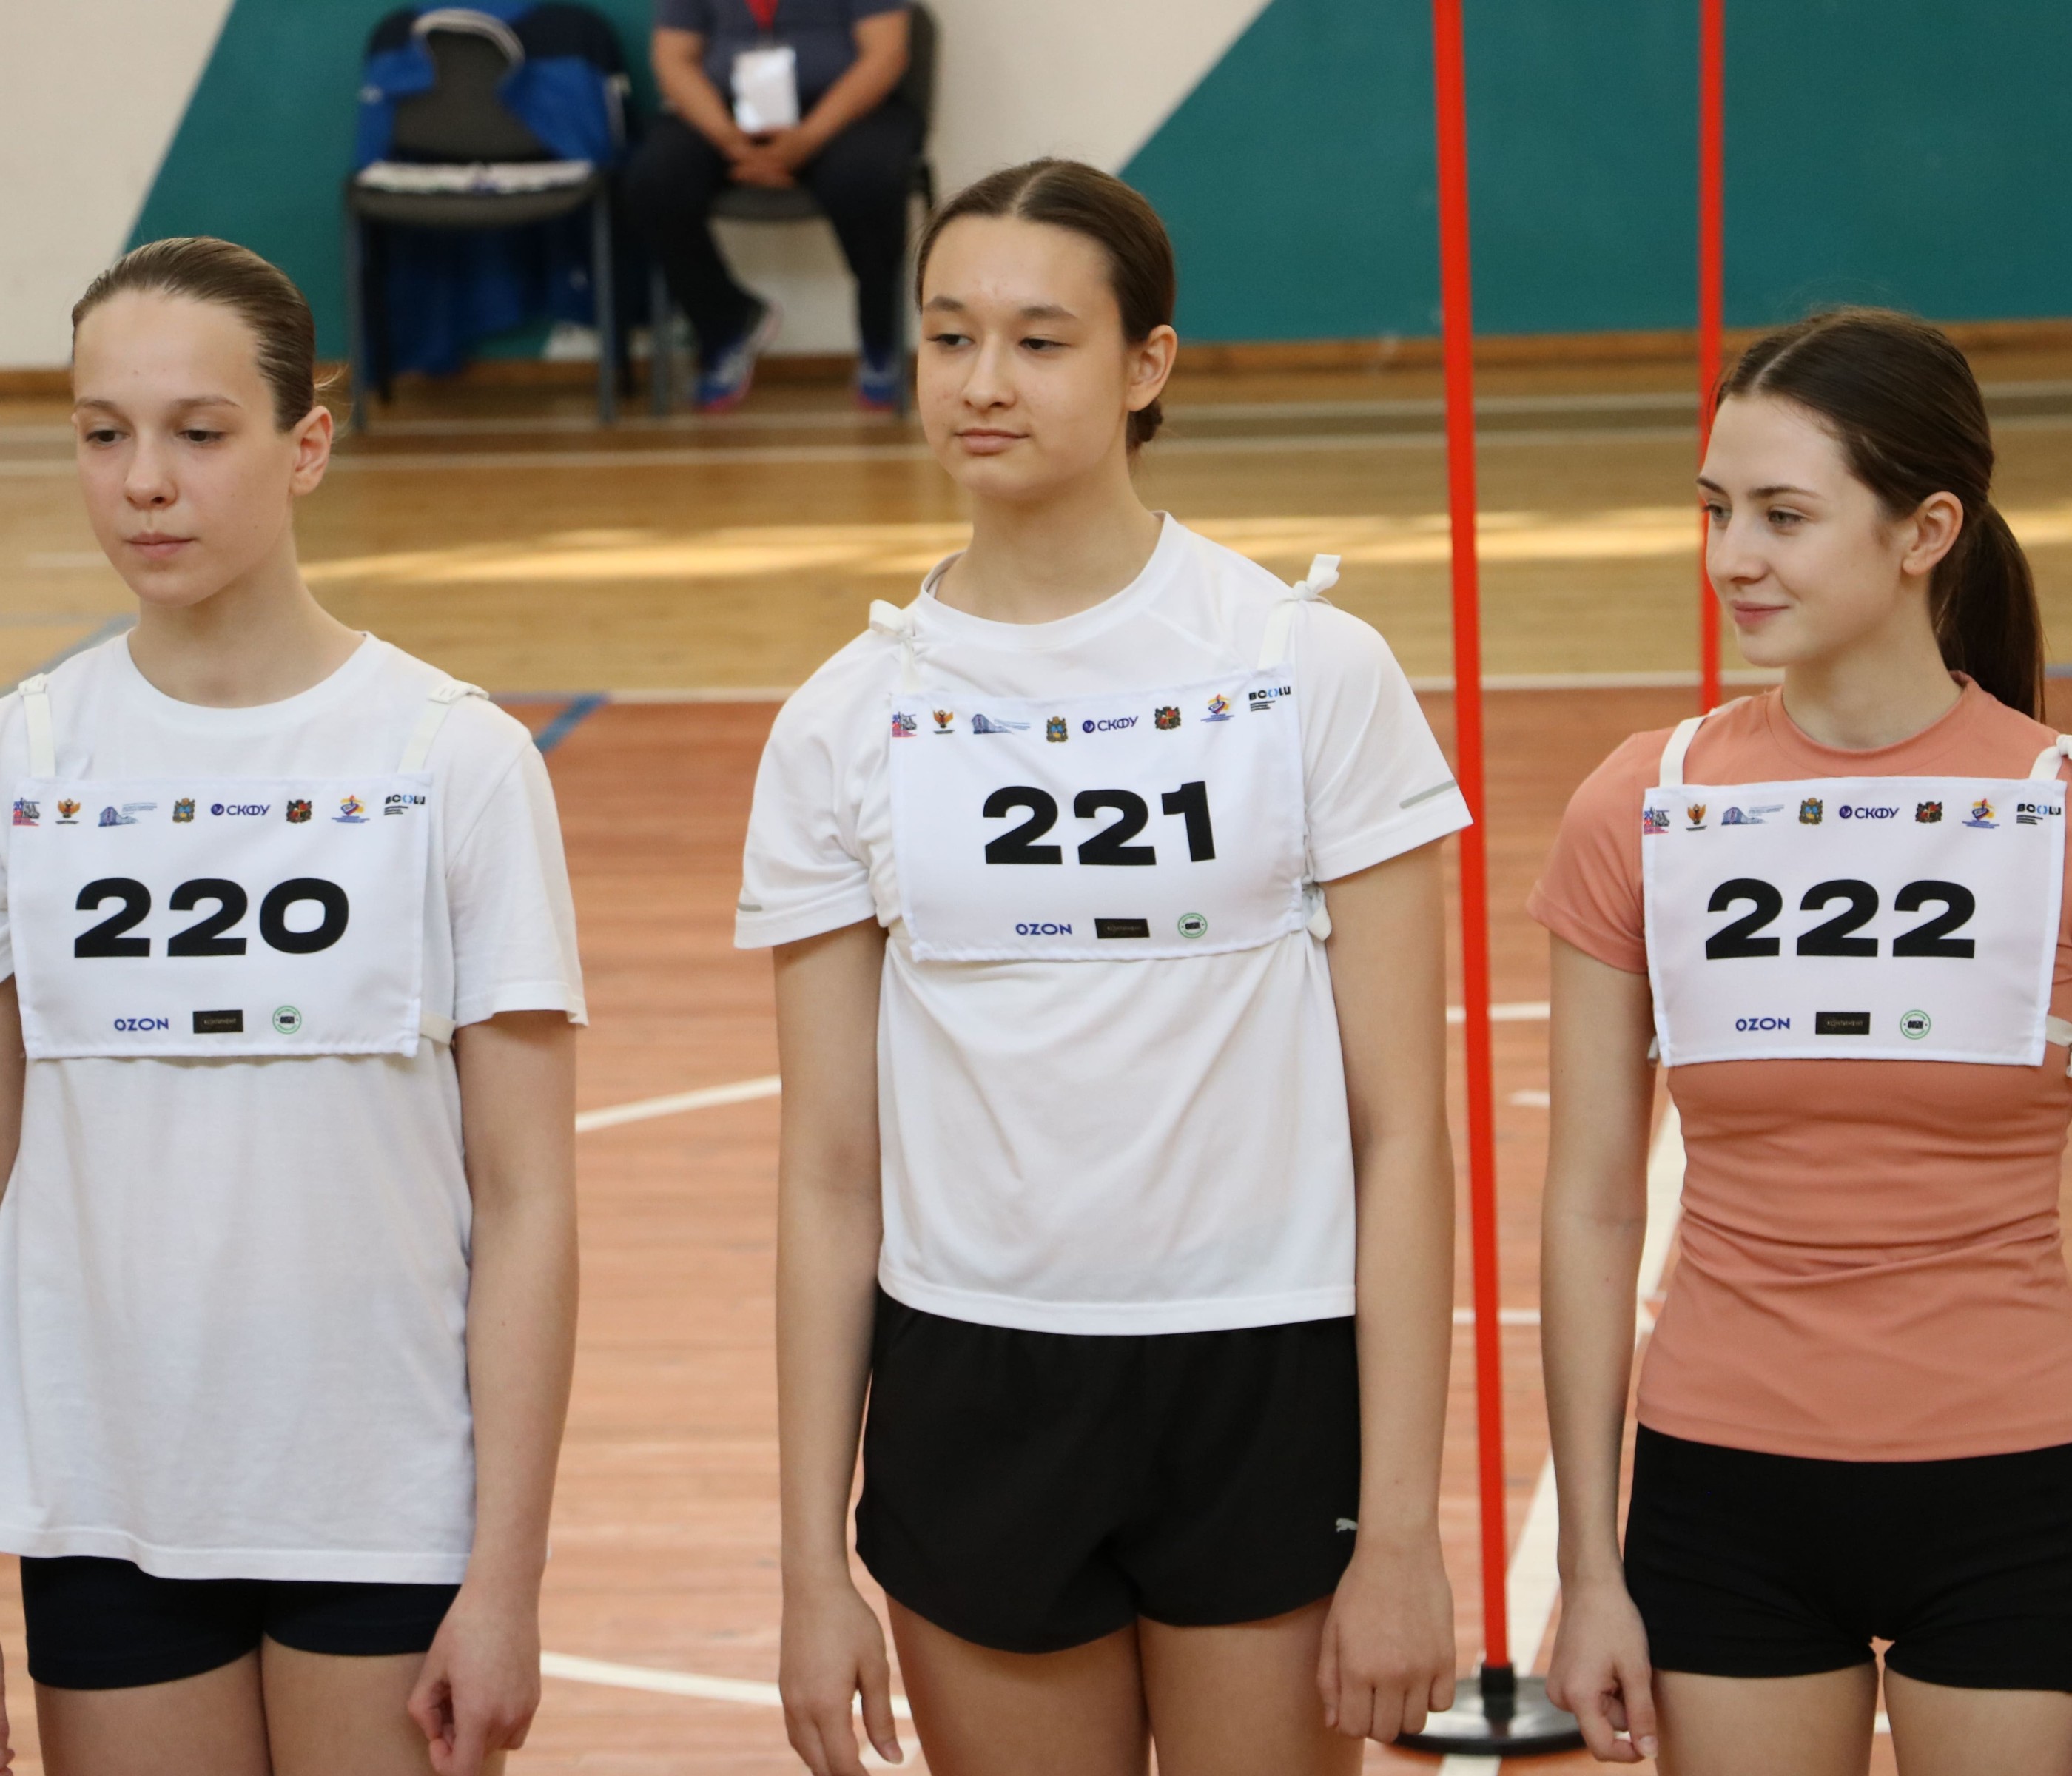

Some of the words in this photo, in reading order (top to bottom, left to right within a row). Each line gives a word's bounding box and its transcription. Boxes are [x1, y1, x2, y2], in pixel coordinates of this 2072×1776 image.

[1098, 715, 1139, 731] СКФУ
[226, 804, 271, 816] СКФУ
[1854, 807, 1900, 820] СКФУ
[983, 781, 1216, 866] 221
[74, 877, 349, 958] 220
[1705, 878, 1976, 960] 222
[1015, 923, 1072, 936] OZON
[114, 1018, 169, 1032] OZON
[1735, 1017, 1791, 1032] OZON
